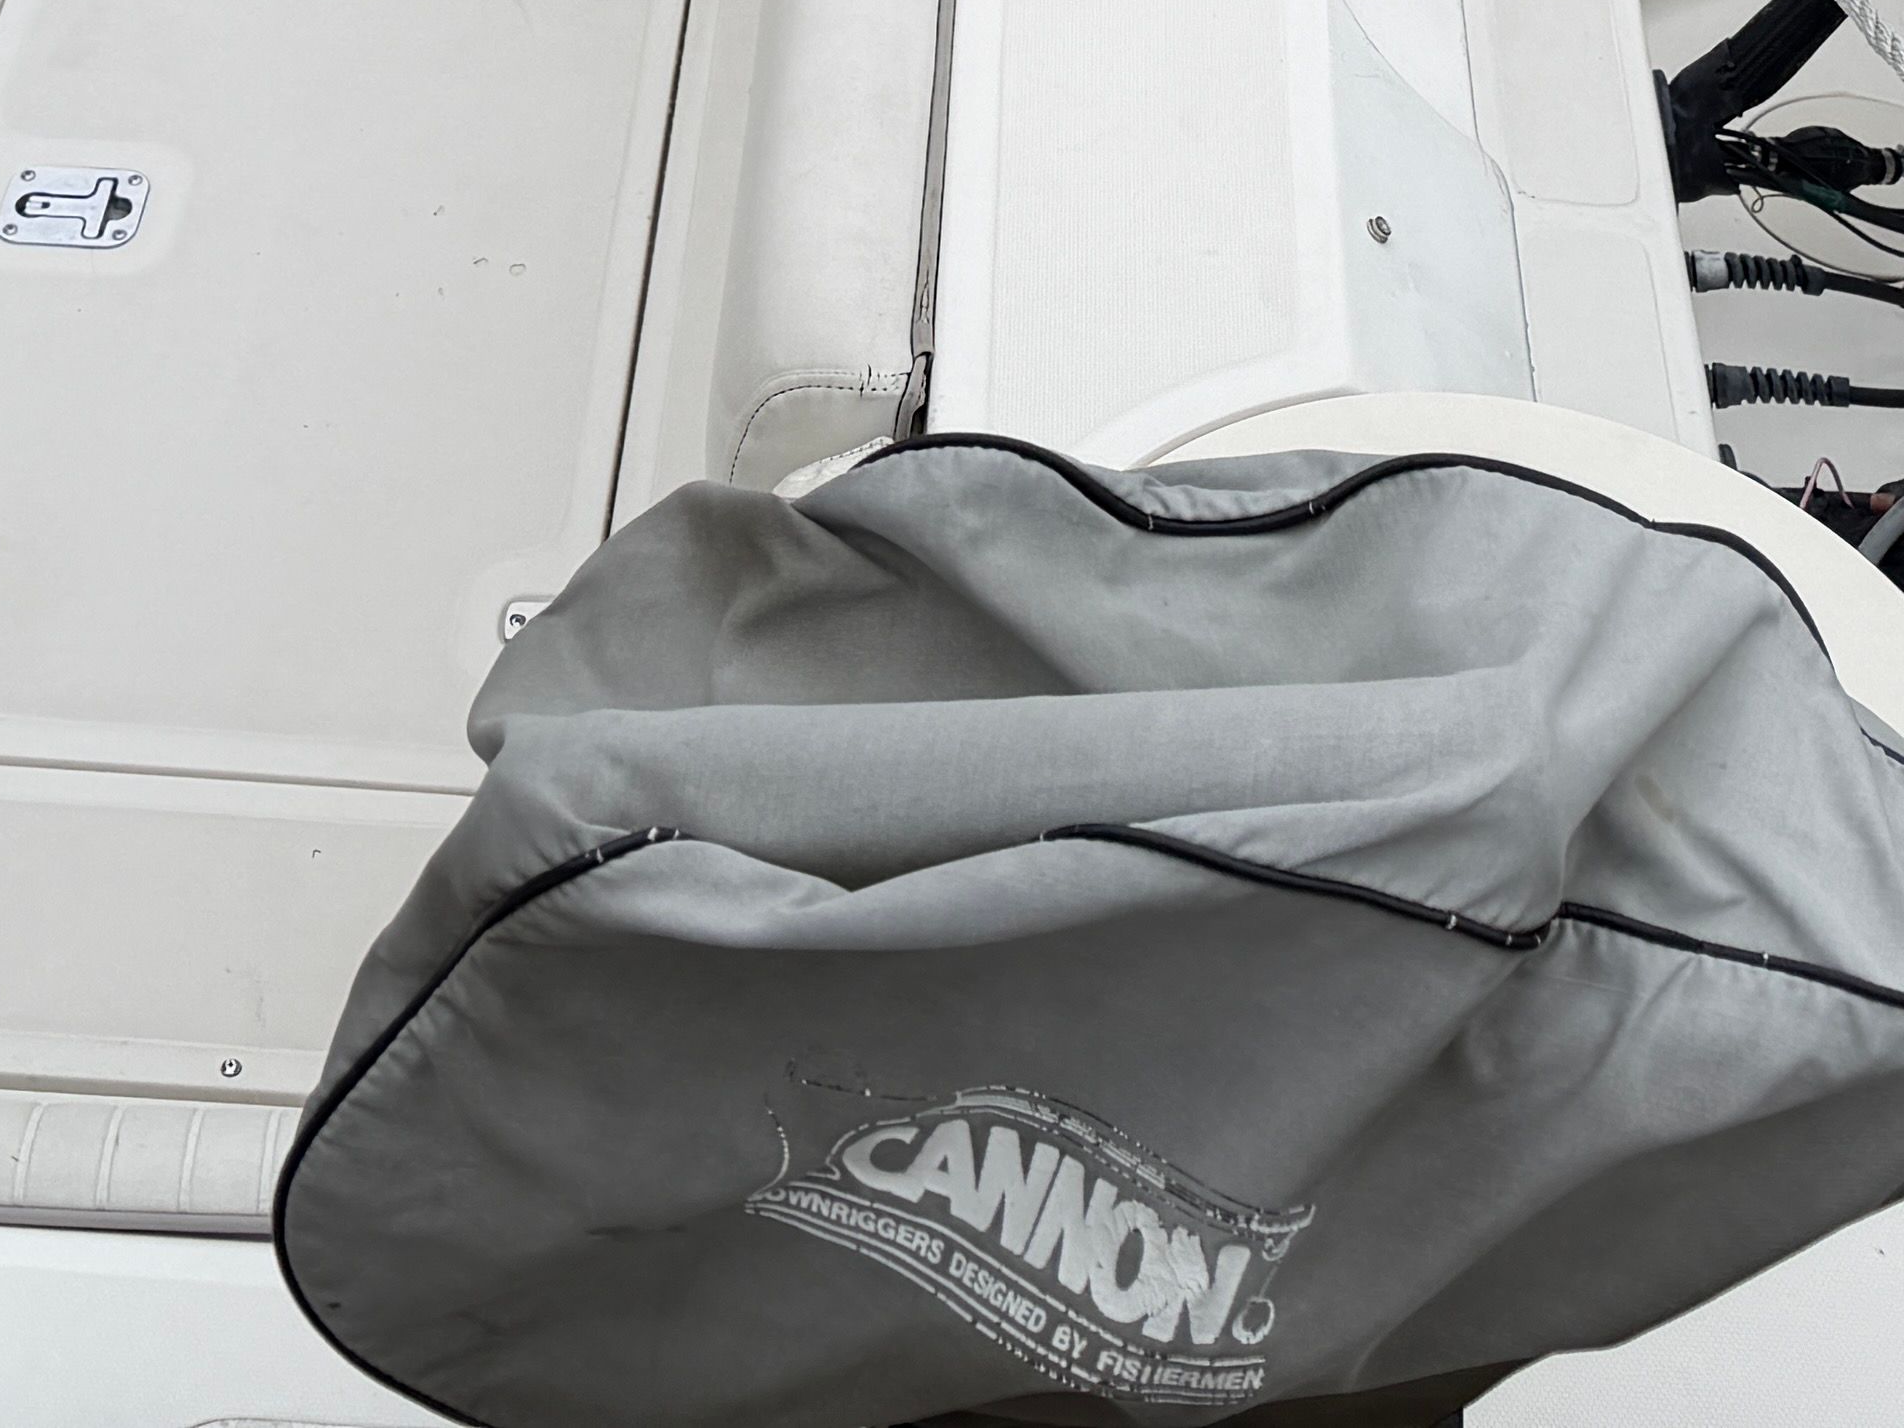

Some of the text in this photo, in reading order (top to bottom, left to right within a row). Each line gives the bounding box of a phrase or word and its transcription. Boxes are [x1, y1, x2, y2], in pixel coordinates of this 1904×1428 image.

[842, 1119, 1251, 1345] CANNON
[949, 1248, 1047, 1332] DESIGNED
[1052, 1325, 1088, 1356] BY
[1096, 1350, 1265, 1390] FISHERMEN
